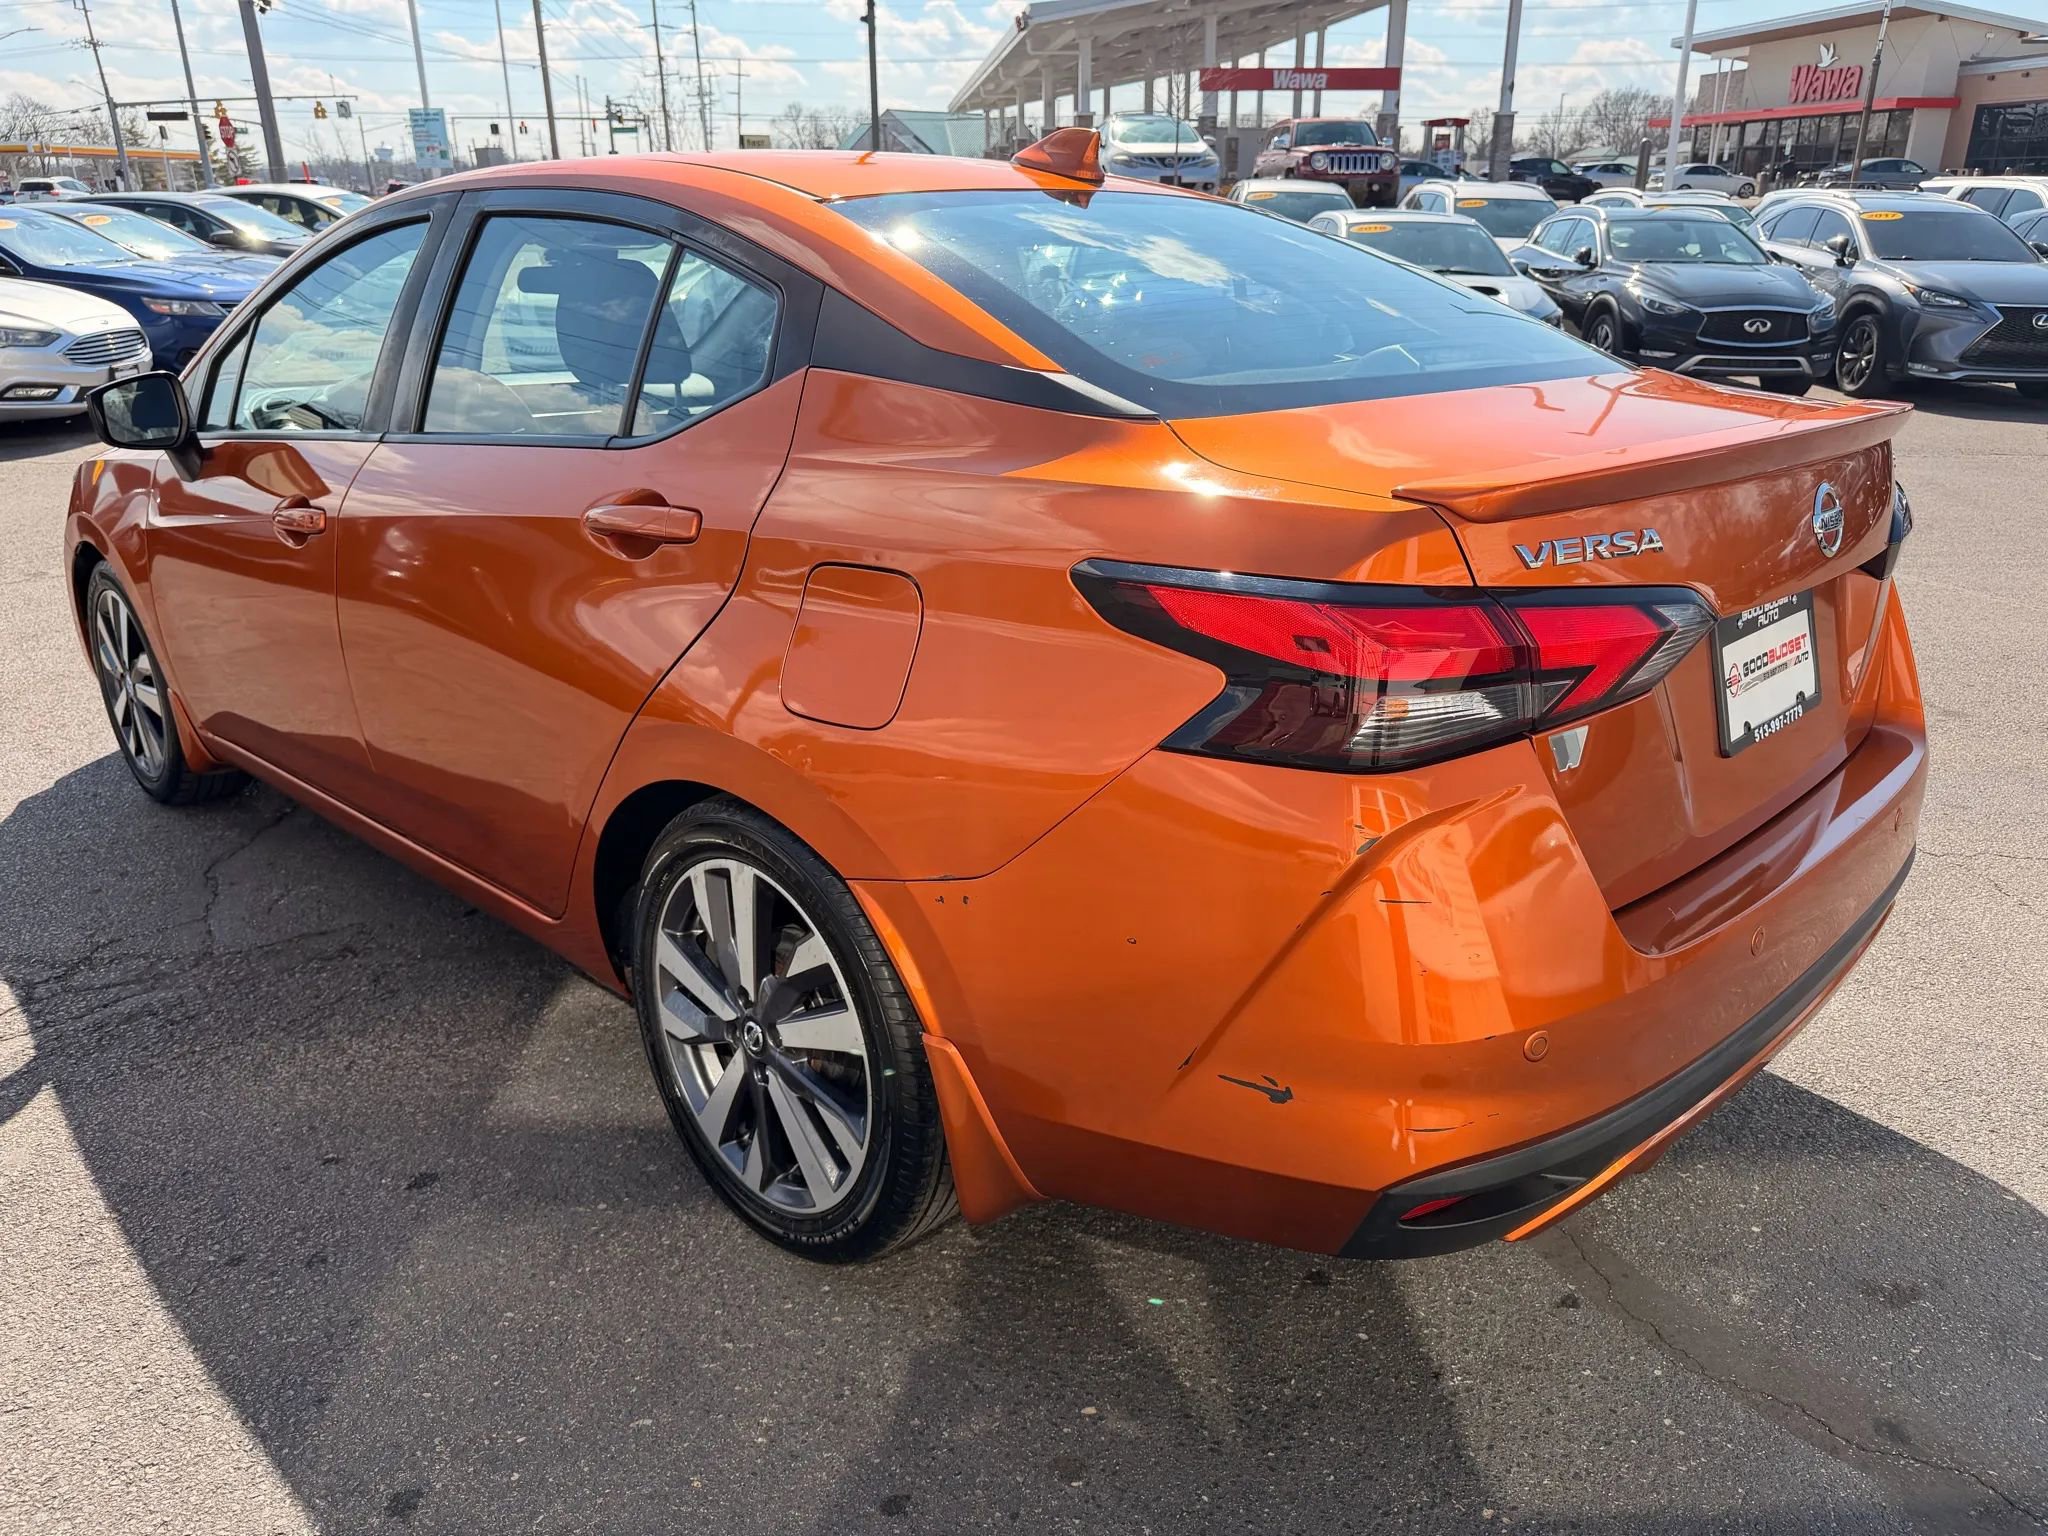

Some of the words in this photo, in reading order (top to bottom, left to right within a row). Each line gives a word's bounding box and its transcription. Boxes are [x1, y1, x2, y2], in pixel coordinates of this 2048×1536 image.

[1272, 70, 1328, 89] Wawa
[1790, 65, 1863, 103] Wawa
[220, 126, 235, 138] STOP
[1513, 527, 1665, 570] VERSA
[1758, 607, 1779, 627] AUTO
[1754, 704, 1803, 743] 513-997-7779
